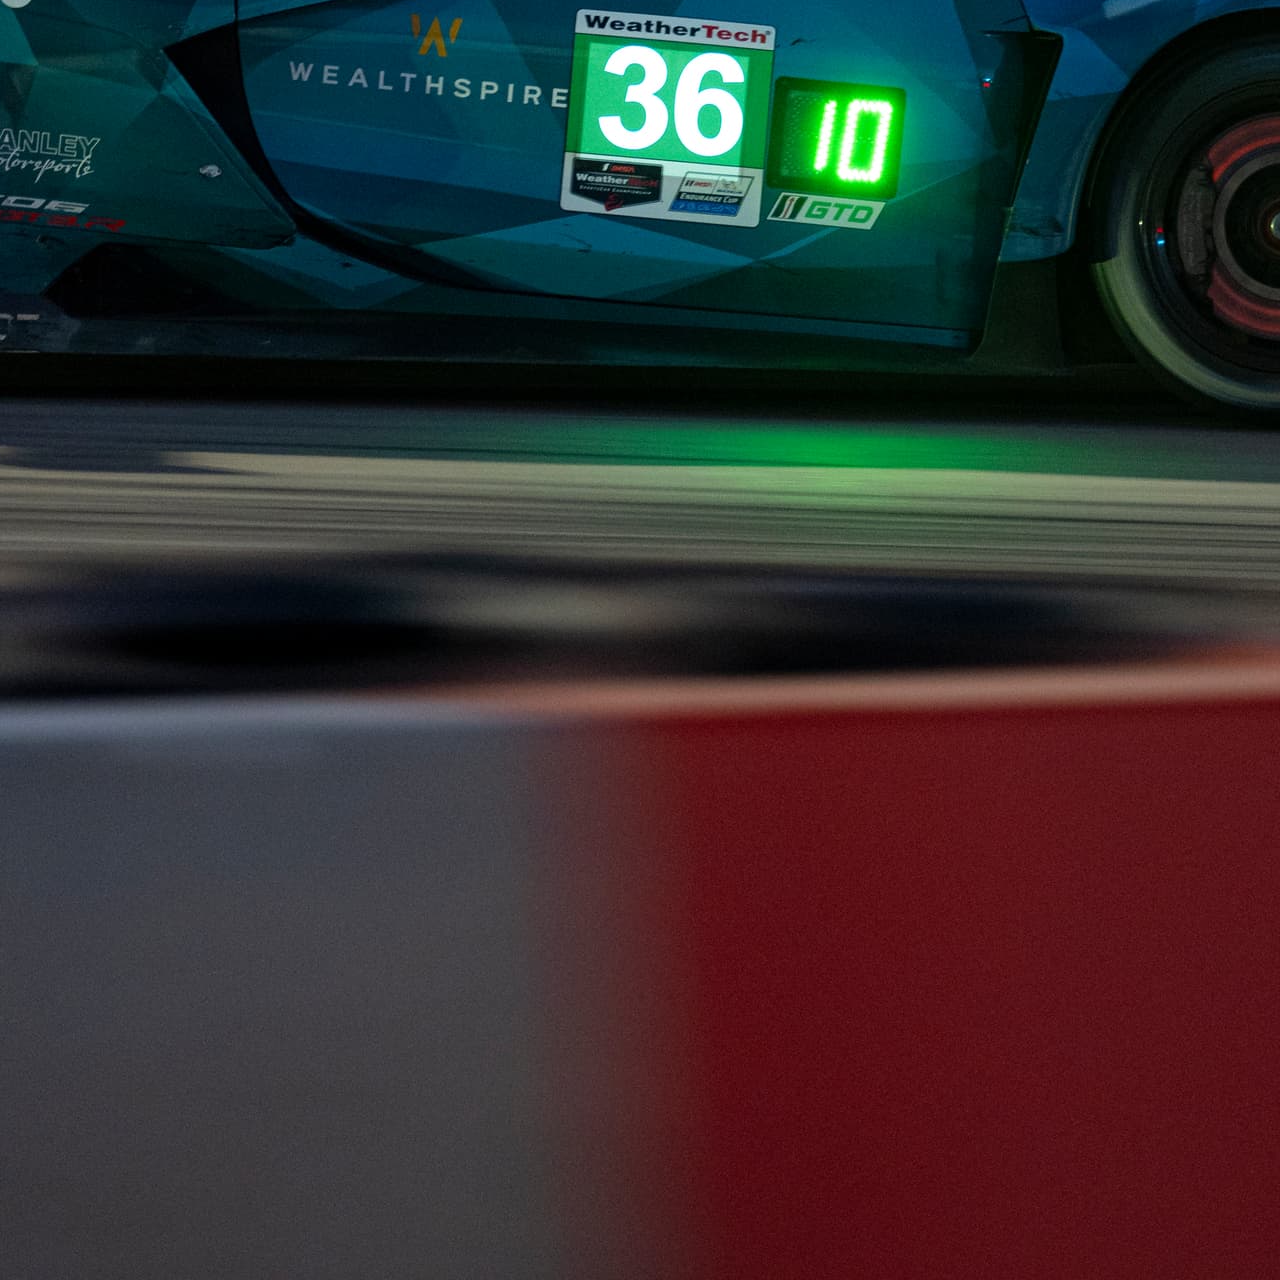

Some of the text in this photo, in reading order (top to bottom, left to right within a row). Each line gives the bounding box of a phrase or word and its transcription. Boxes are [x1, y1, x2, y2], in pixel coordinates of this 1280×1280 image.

[584, 13, 768, 45] WeatherTech
[289, 61, 569, 109] WEALTHSPIRE
[597, 44, 746, 158] 36
[813, 97, 894, 185] 10
[804, 200, 874, 223] GTD
